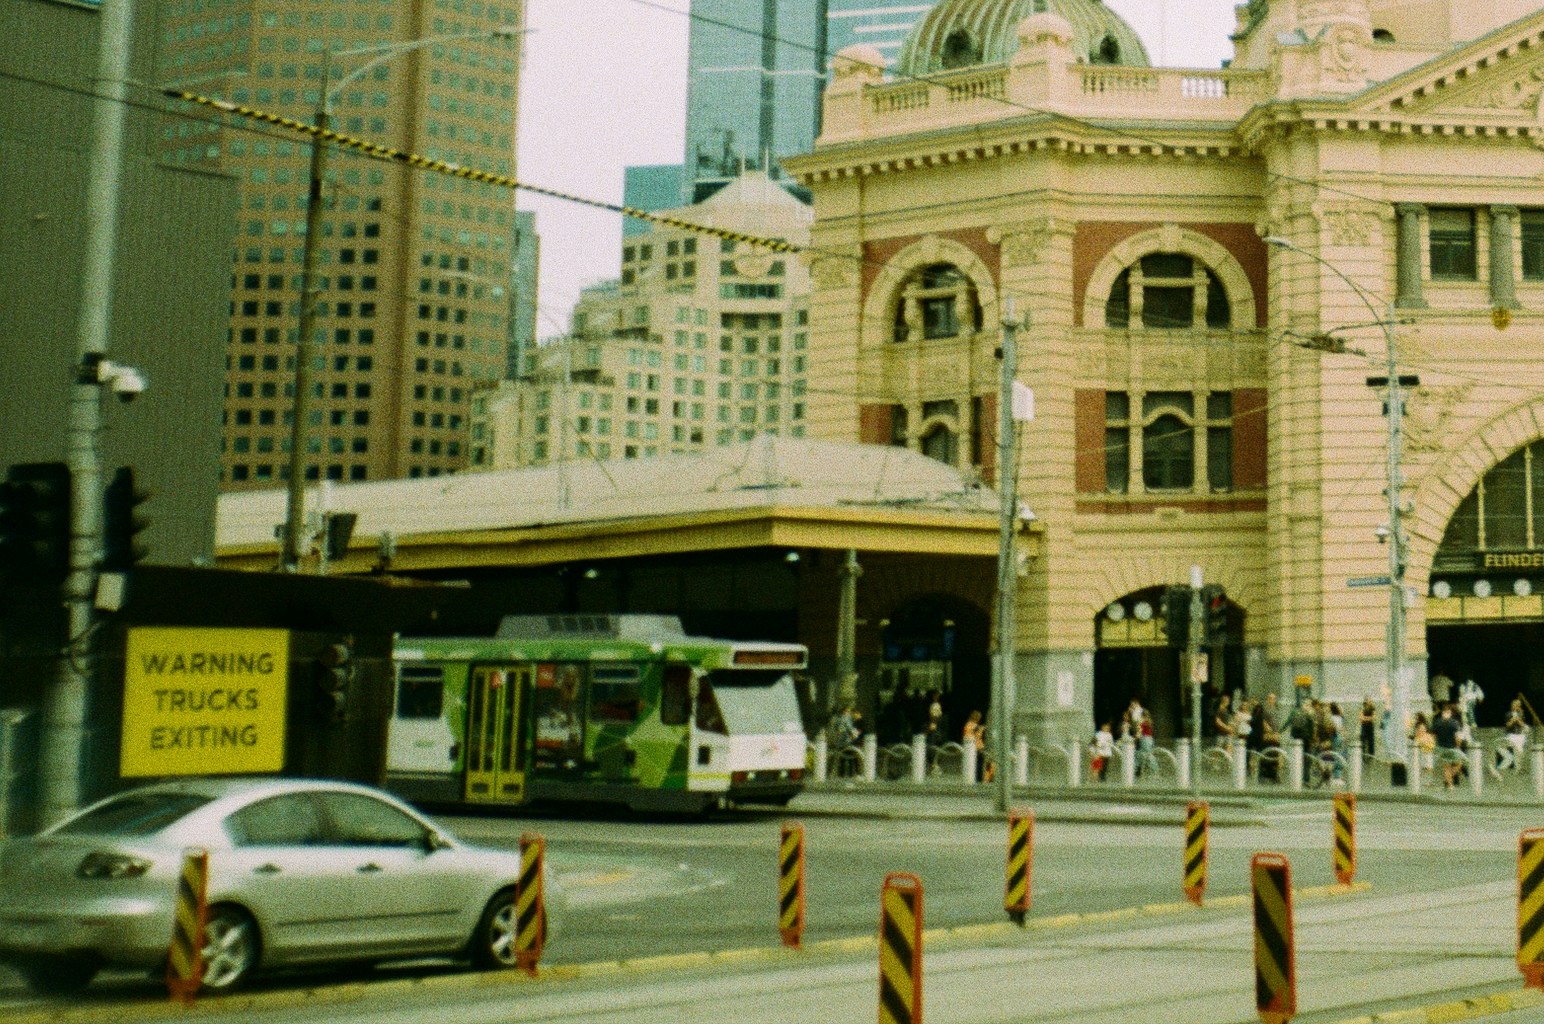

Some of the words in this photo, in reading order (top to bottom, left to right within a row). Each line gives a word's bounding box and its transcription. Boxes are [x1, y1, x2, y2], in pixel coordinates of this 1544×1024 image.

[141, 651, 274, 676] WARNING
[152, 687, 259, 712] TRUCKS
[150, 724, 259, 750] EXITING
